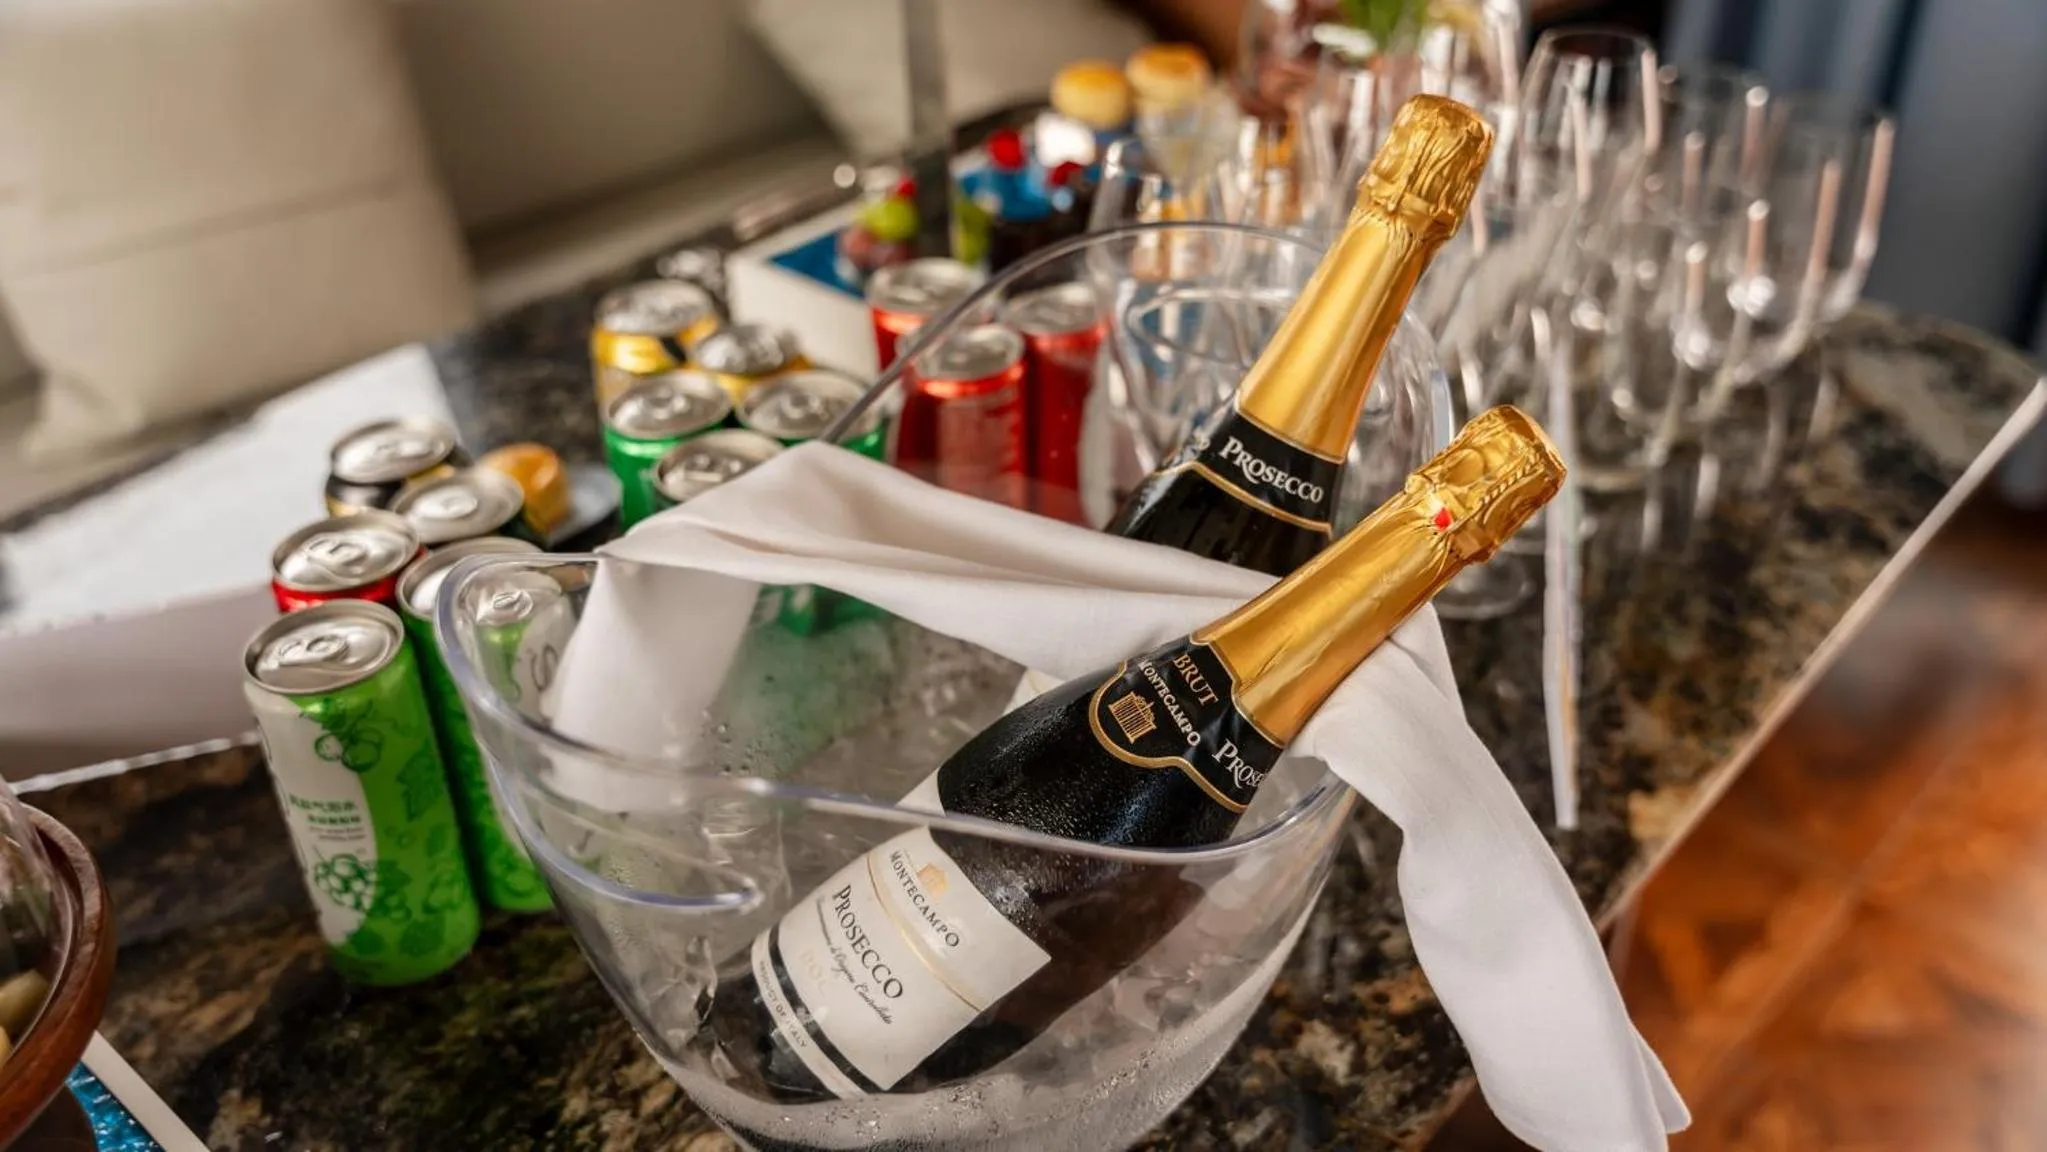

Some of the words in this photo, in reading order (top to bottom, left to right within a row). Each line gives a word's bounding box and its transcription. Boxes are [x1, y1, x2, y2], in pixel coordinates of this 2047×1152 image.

[1219, 436, 1323, 504] PROSECCO
[1138, 658, 1201, 747] MONTECAMPO
[1173, 653, 1220, 707] BRUT
[831, 884, 904, 999] PROSECCO
[889, 848, 960, 948] MONTECAMPO
